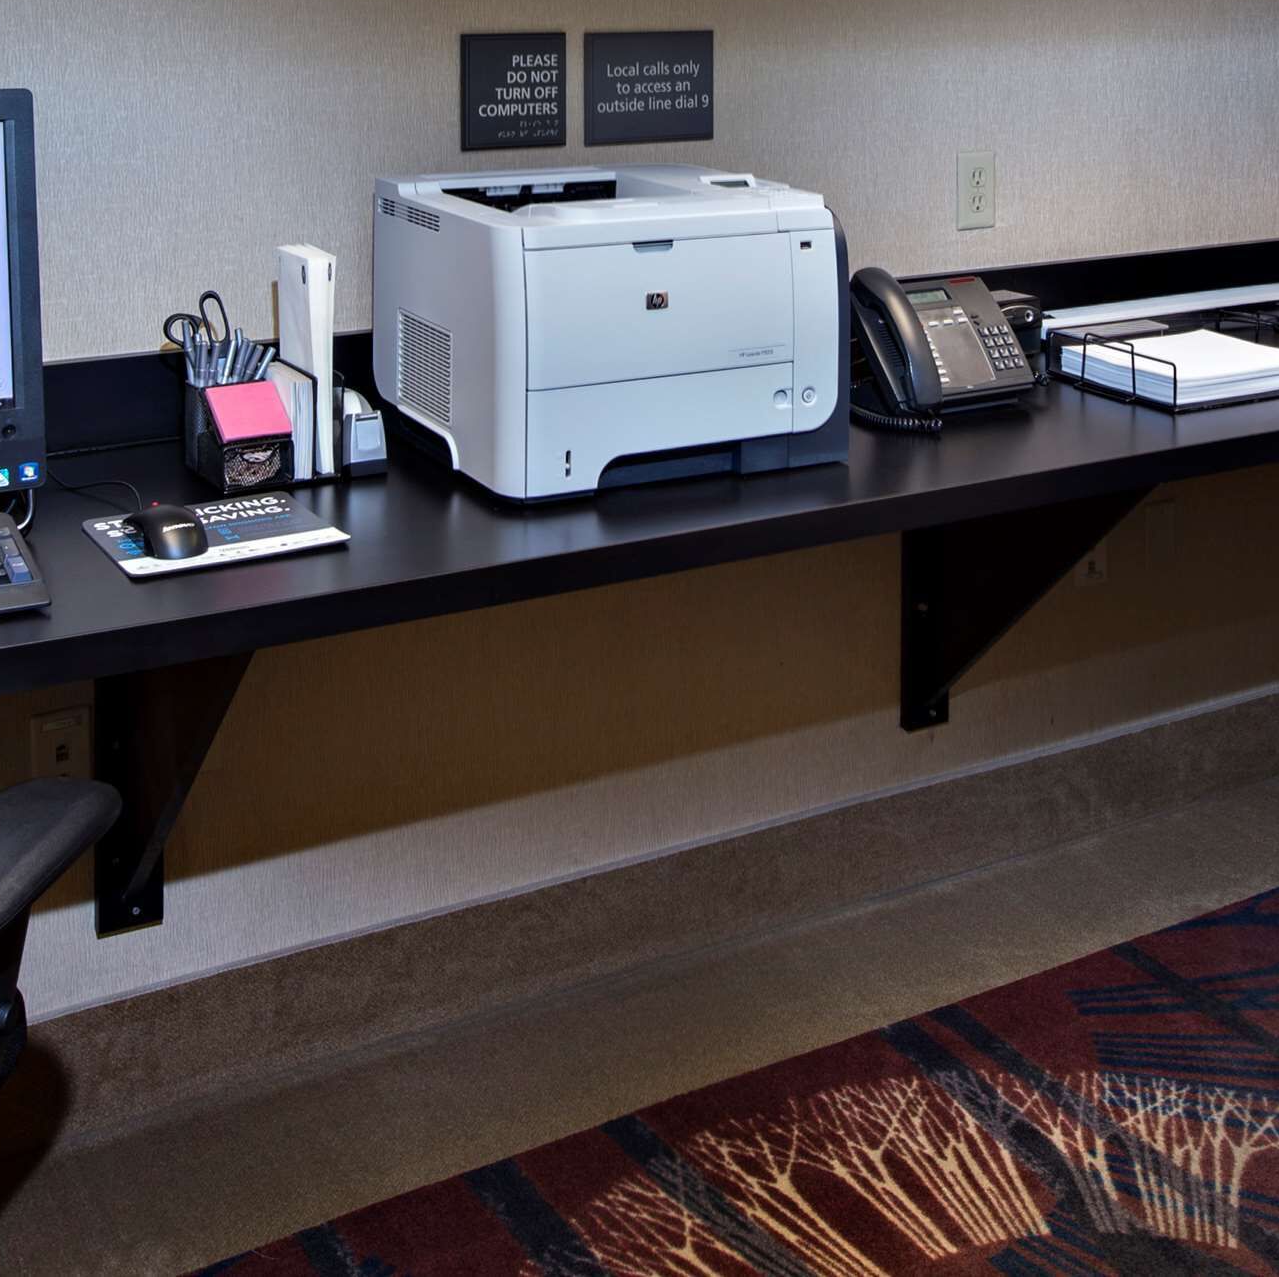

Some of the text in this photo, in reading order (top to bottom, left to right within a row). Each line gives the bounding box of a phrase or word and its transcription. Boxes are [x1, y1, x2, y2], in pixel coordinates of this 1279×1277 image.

[512, 53, 559, 68] PLEASE
[607, 59, 700, 78] Local calls only
[507, 69, 559, 84] DO NOT
[495, 86, 559, 100] TURN OFF
[616, 80, 691, 95] to access an
[478, 102, 558, 117] COMPUTERS
[597, 93, 709, 114] outside line dial 9
[194, 496, 287, 516] ICKING.
